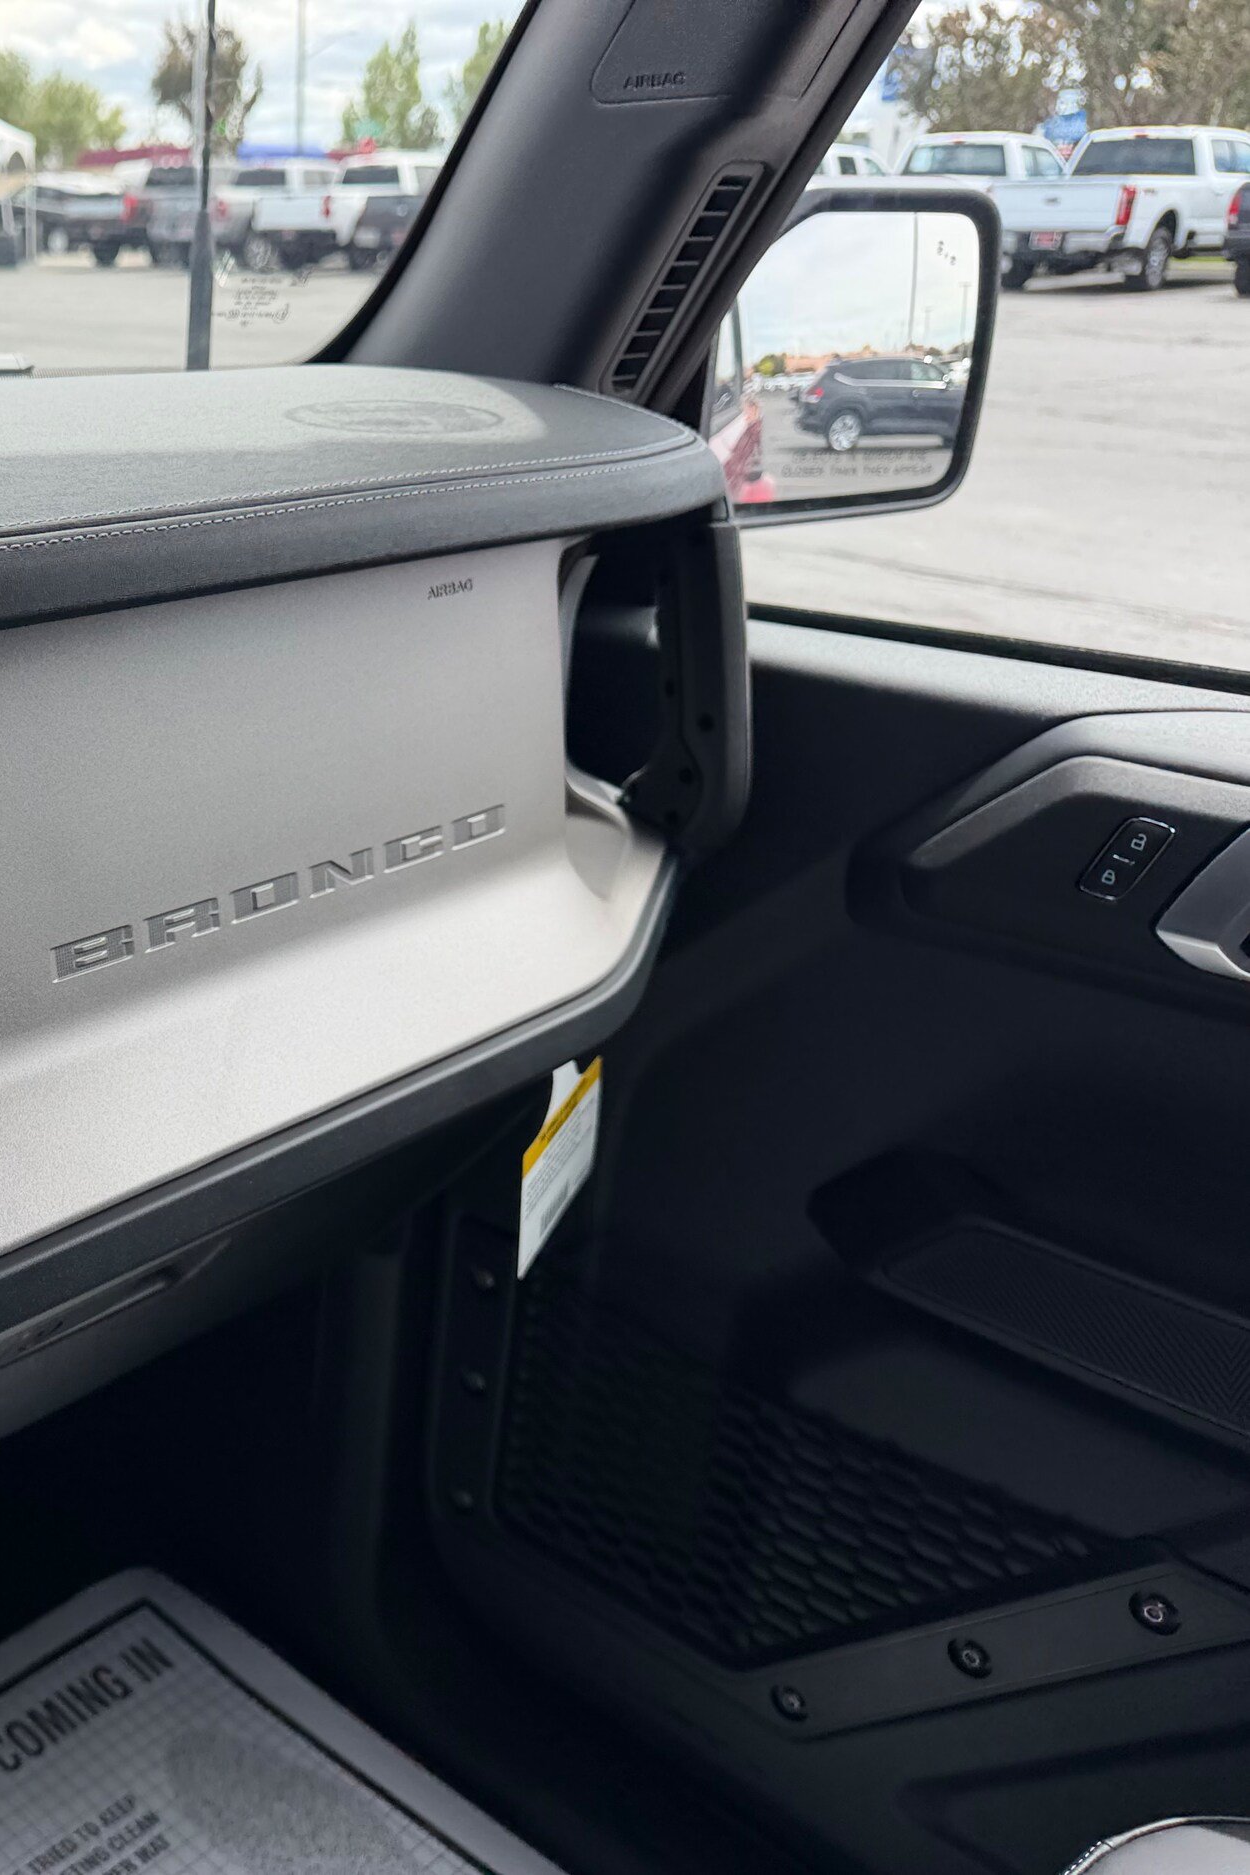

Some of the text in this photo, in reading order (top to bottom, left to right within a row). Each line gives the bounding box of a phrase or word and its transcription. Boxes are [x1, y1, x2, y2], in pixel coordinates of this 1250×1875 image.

[623, 71, 686, 90] AIRBAG
[427, 578, 474, 600] AIRBAG
[49, 803, 507, 984] BRONCO
[122, 1636, 175, 1681] IN
